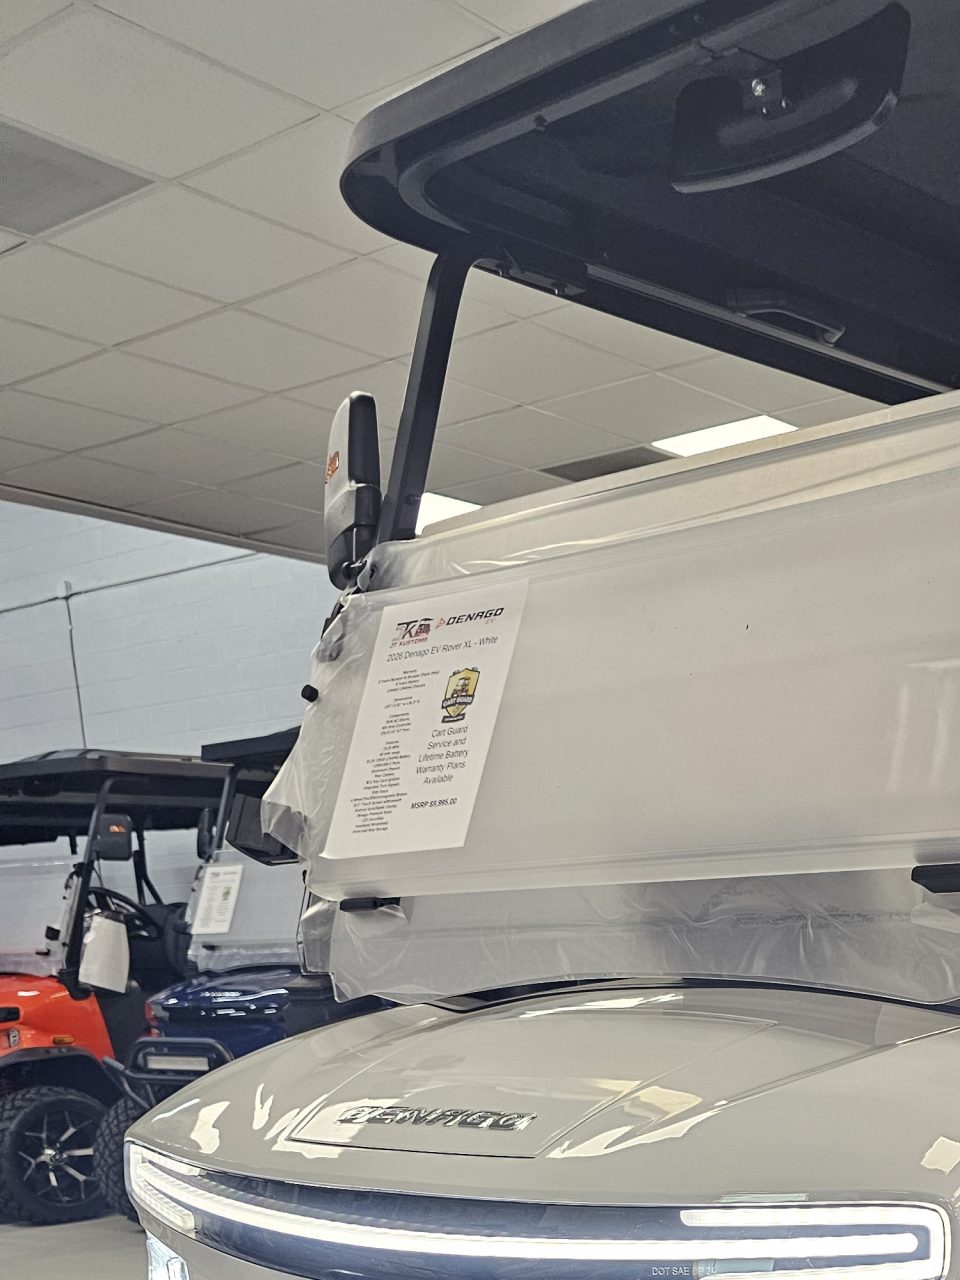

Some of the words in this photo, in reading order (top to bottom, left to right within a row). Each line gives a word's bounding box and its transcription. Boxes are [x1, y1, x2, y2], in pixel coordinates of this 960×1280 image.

[446, 607, 504, 626] DENAGO
[404, 648, 430, 660] Denago
[441, 643, 463, 652] Rover
[463, 640, 473, 648] XL
[479, 636, 499, 647] White
[431, 728, 447, 738] Cart
[447, 724, 468, 735] Guard
[427, 740, 452, 750] Service
[453, 736, 467, 747] and
[418, 751, 444, 763] Lifetime
[445, 749, 469, 760] Battery
[416, 763, 445, 774] Warranty
[446, 760, 466, 771] Plans
[423, 773, 454, 785] Available
[411, 801, 429, 809] MSRP
[652, 1266, 671, 1276] DOT
[672, 1266, 690, 1276] SAE
